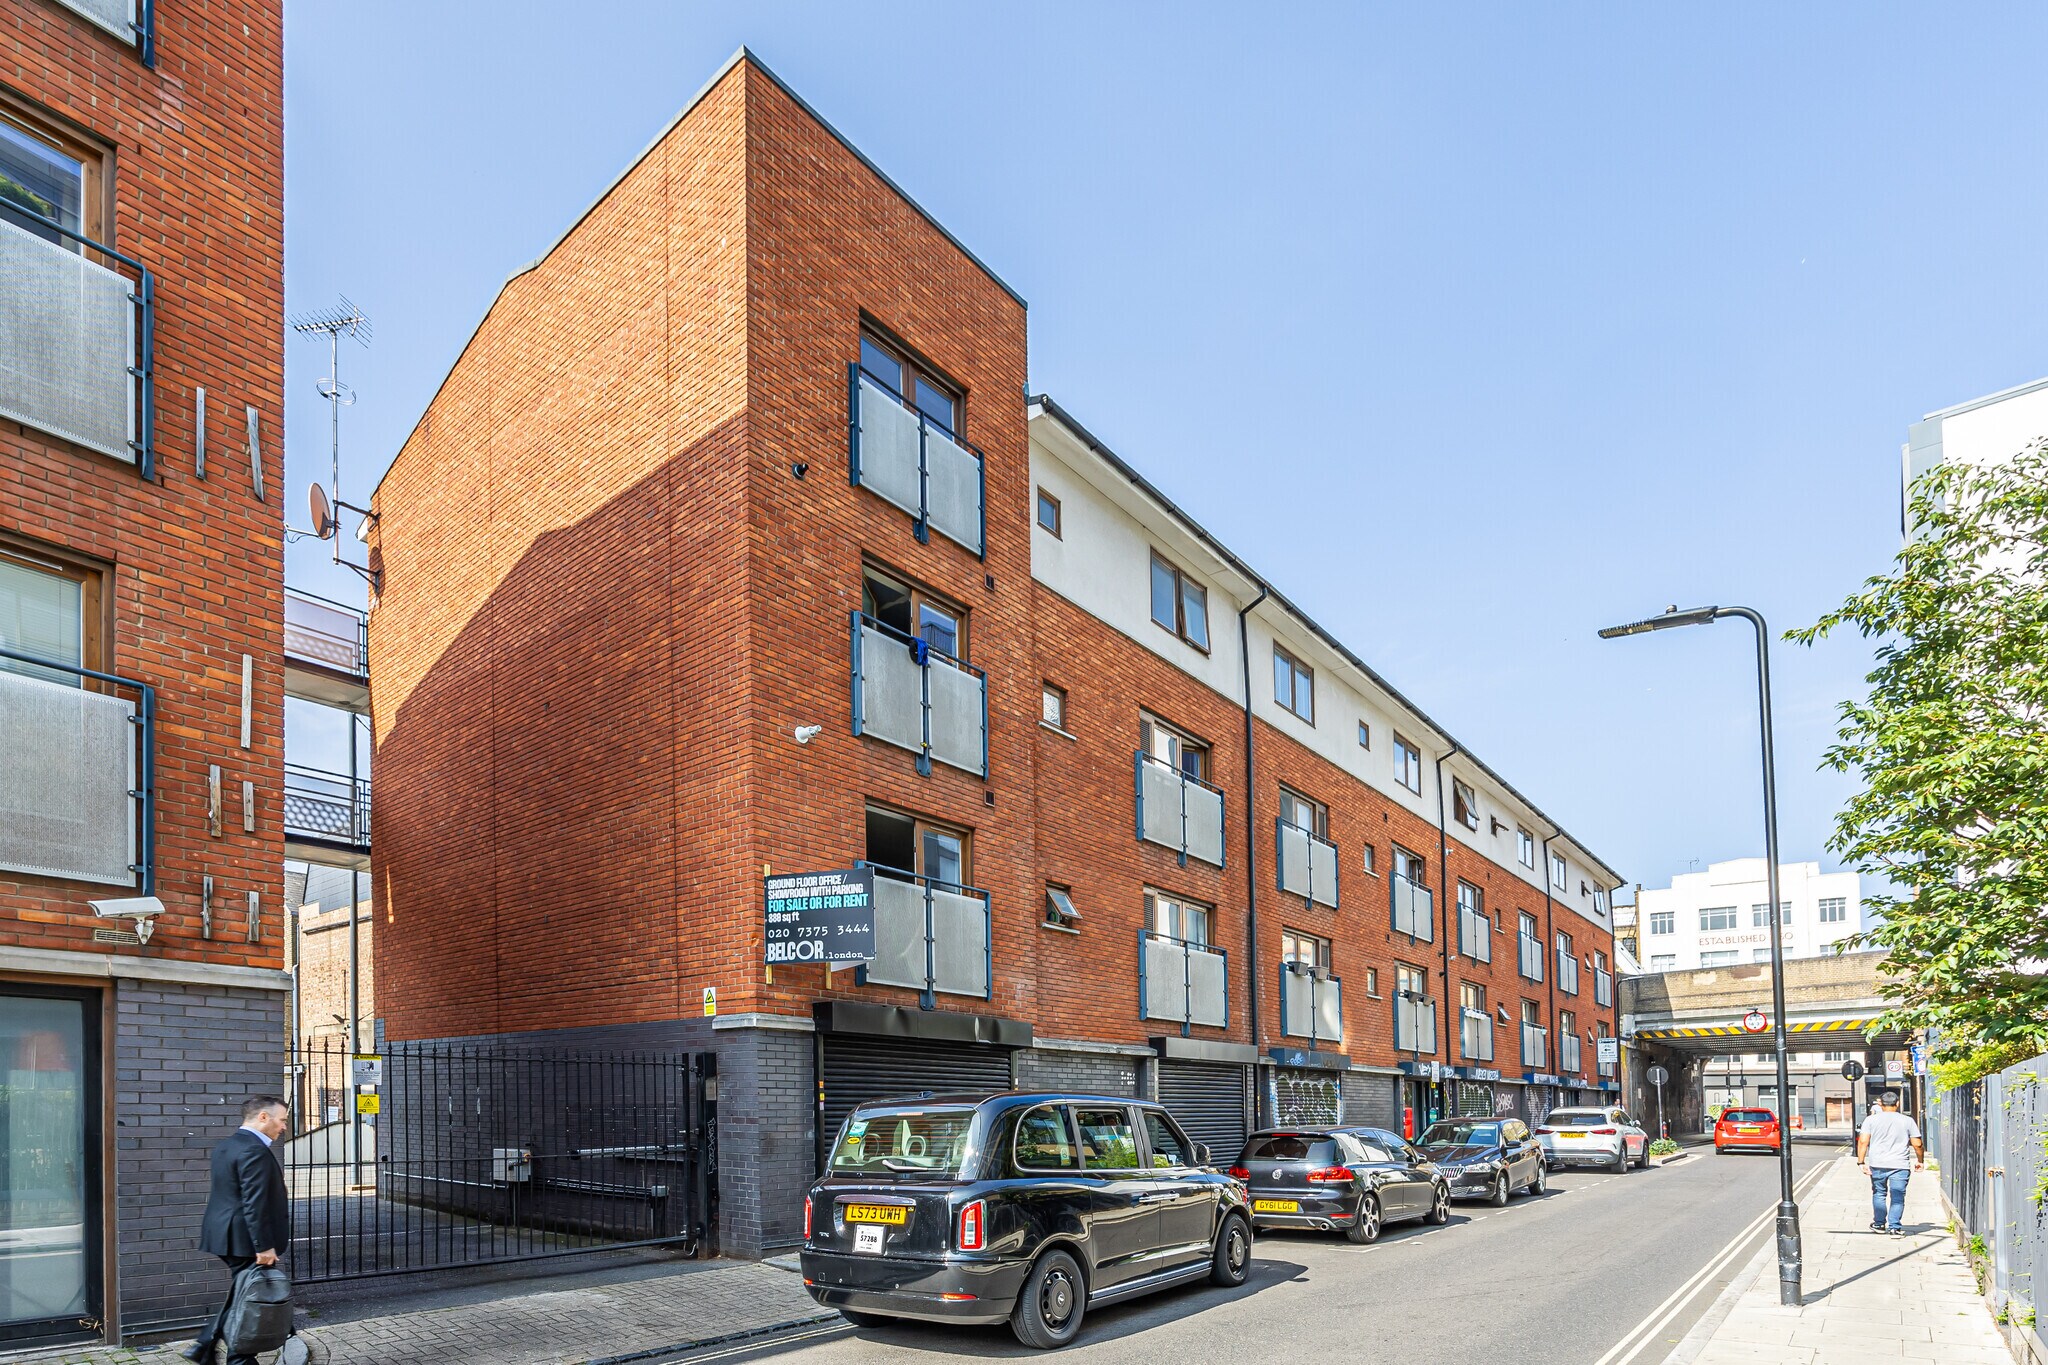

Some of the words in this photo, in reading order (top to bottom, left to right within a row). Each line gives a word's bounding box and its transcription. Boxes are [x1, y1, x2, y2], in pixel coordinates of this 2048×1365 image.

[768, 879, 795, 889] GROUND
[796, 877, 817, 887] FLOOR
[818, 875, 841, 885] OFFICE
[768, 887, 809, 899] SHOWROOM
[810, 885, 831, 896] WITH
[832, 883, 863, 895] PARKING
[768, 899, 785, 912] FOR
[786, 898, 808, 910] SALE
[809, 896, 823, 909] OR
[823, 895, 842, 908] FOR
[843, 894, 868, 907] RENT
[782, 914, 791, 923] sq
[792, 912, 799, 921] ft
[768, 929, 790, 938] 020
[798, 927, 828, 937] 7375
[837, 924, 869, 935] 3444
[1699, 934, 1766, 945] ESTABLISHED
[1260, 1201, 1276, 1209] GY61
[850, 1206, 877, 1219] LS73
[880, 1208, 901, 1220] UWH
